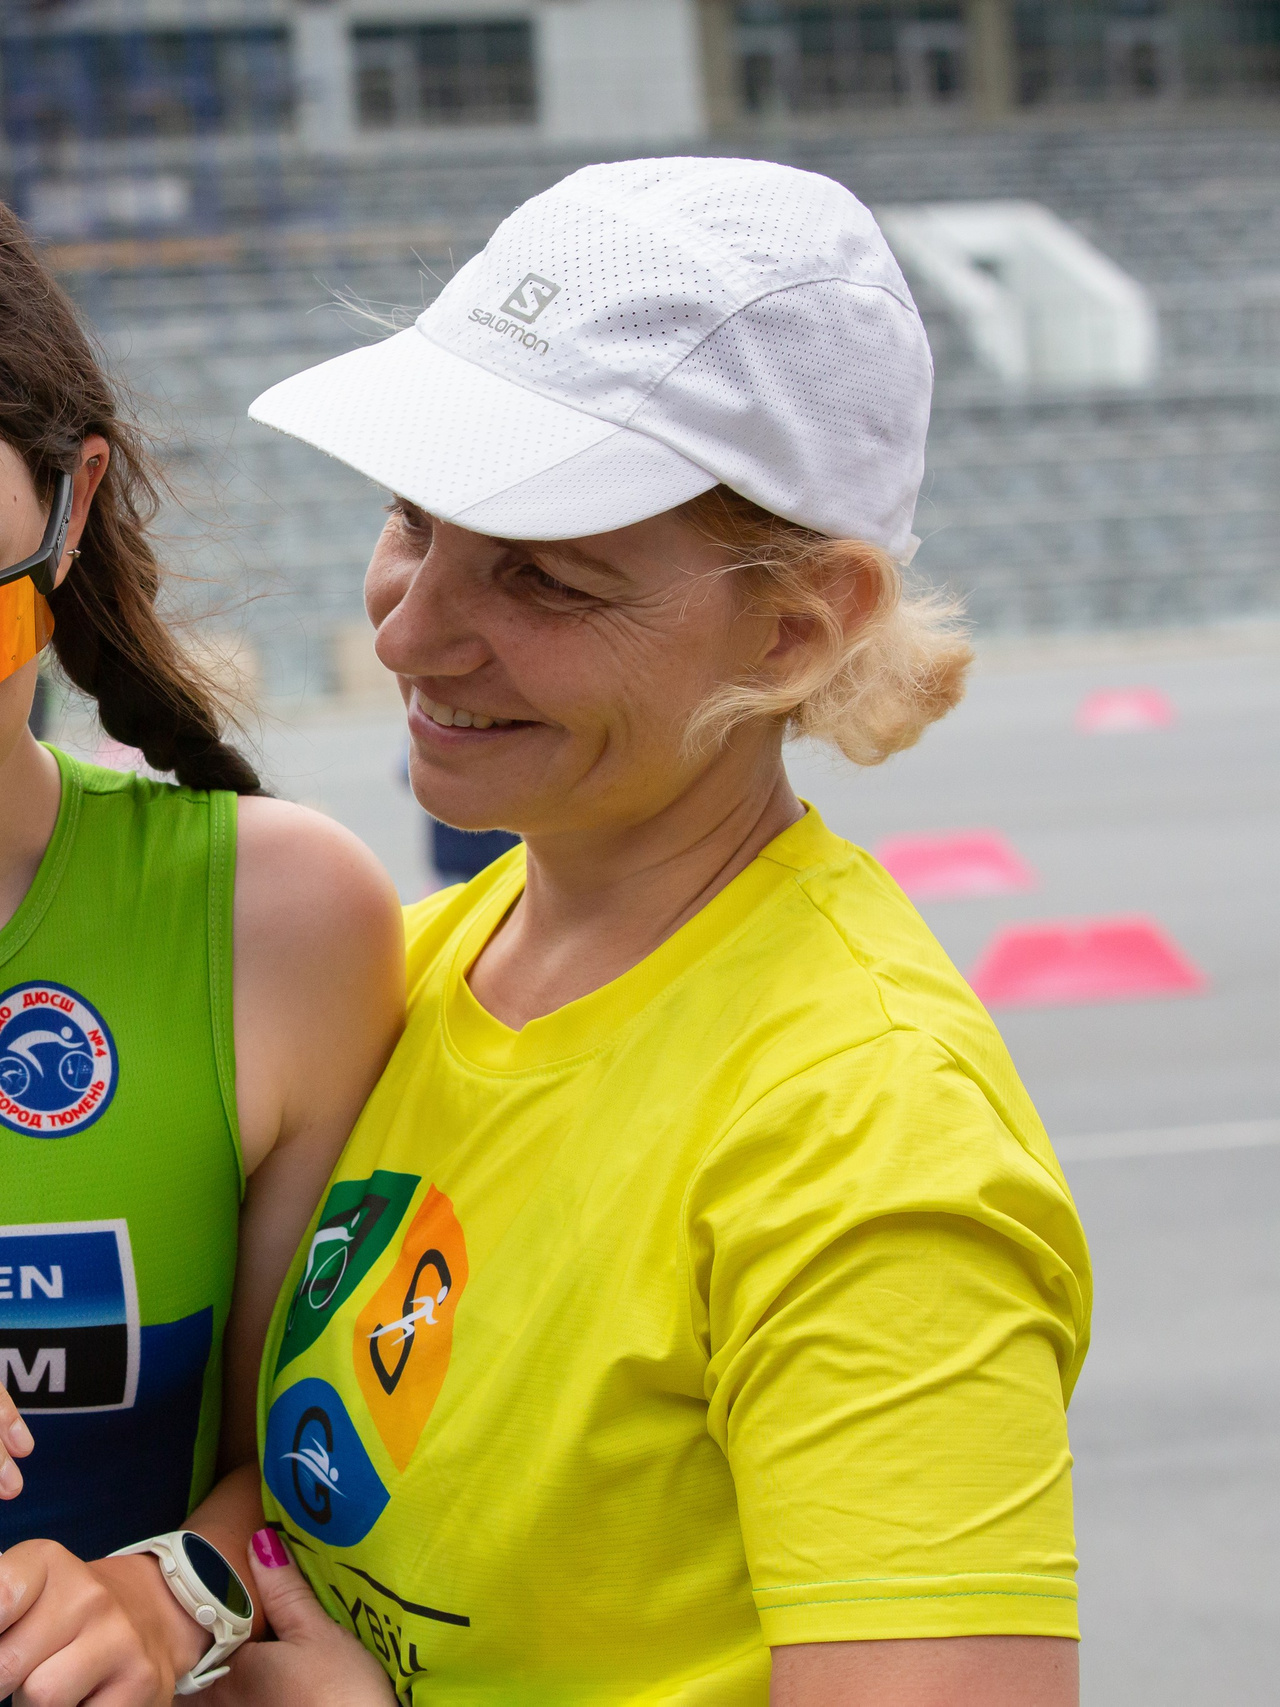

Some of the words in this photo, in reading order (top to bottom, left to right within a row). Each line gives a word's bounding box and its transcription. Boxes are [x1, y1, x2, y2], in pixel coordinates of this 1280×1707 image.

[467, 308, 550, 357] salomon
[22, 991, 75, 1014] ДЮСШ
[47, 1080, 106, 1128] ТЮМЕНЬ
